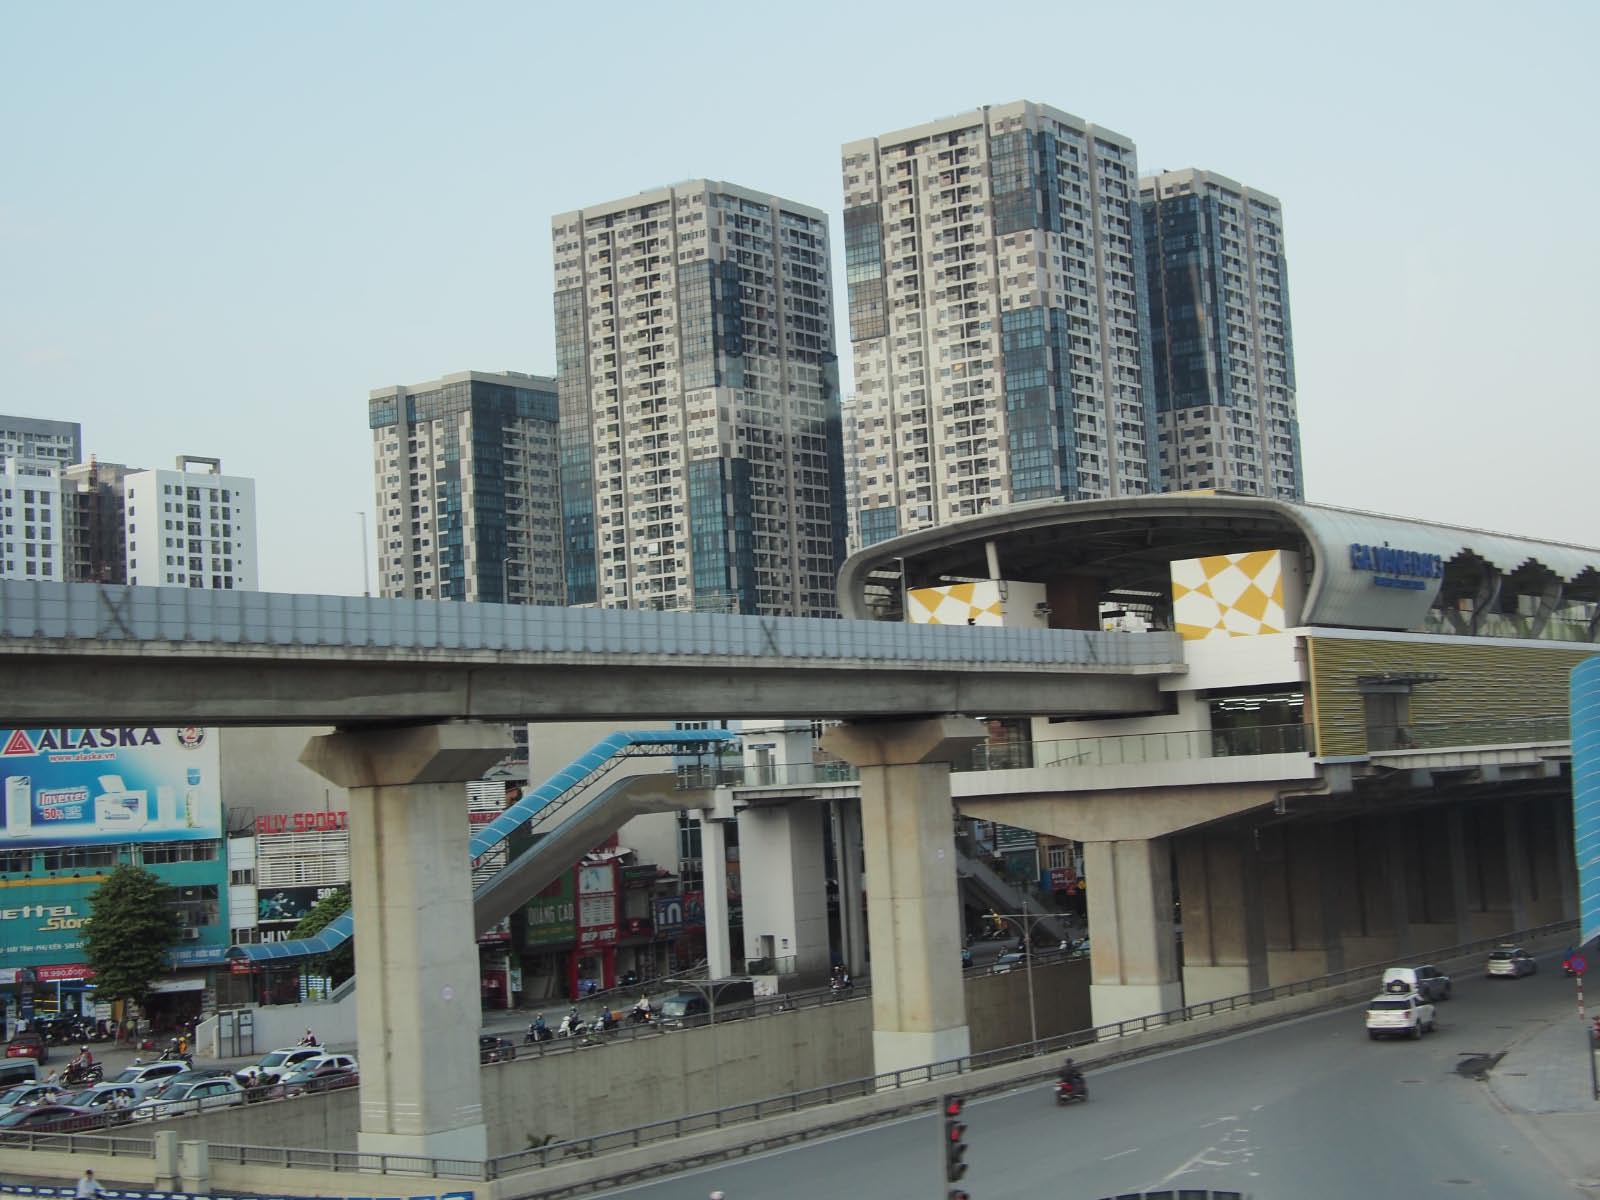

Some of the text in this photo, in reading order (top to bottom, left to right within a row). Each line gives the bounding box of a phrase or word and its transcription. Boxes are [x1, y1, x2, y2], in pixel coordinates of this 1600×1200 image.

[38, 727, 161, 750] ALASKA
[49, 752, 116, 762] www.alaska.vn
[40, 791, 88, 806] Inverter
[256, 811, 348, 833] HUY SPORT
